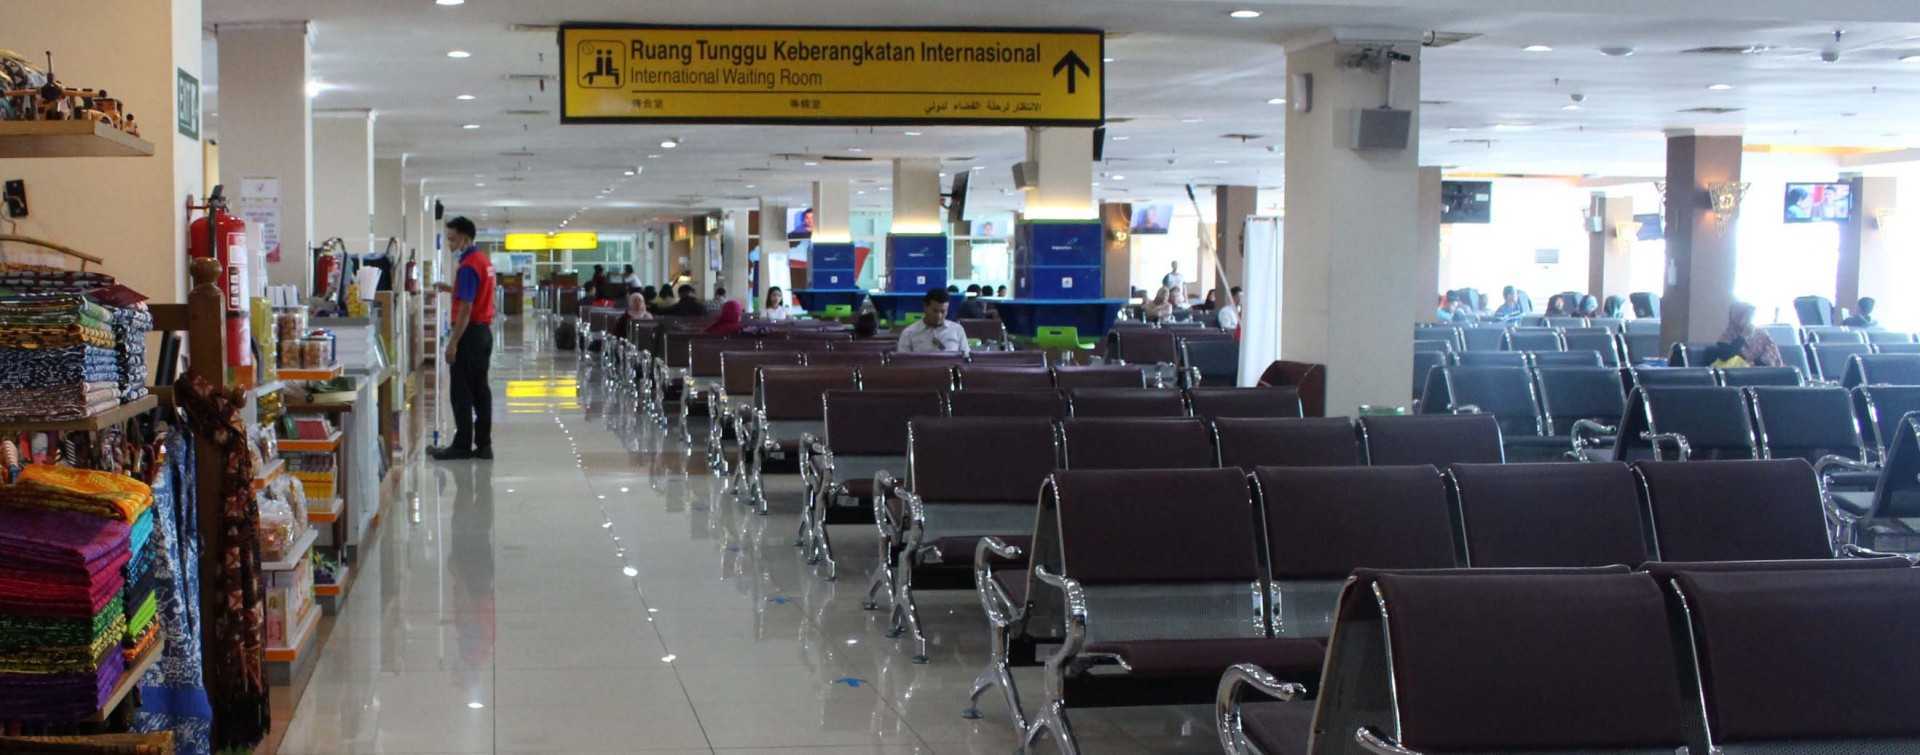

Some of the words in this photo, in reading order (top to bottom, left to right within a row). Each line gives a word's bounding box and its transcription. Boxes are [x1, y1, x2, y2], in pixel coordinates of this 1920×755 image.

[631, 39, 692, 65] Ruang
[696, 40, 767, 66] Tunggu
[774, 40, 915, 66] Keberangkatan
[921, 41, 1041, 63] Internasional
[631, 67, 719, 84] International
[722, 68, 776, 89] Waiting
[780, 69, 822, 86] Room
